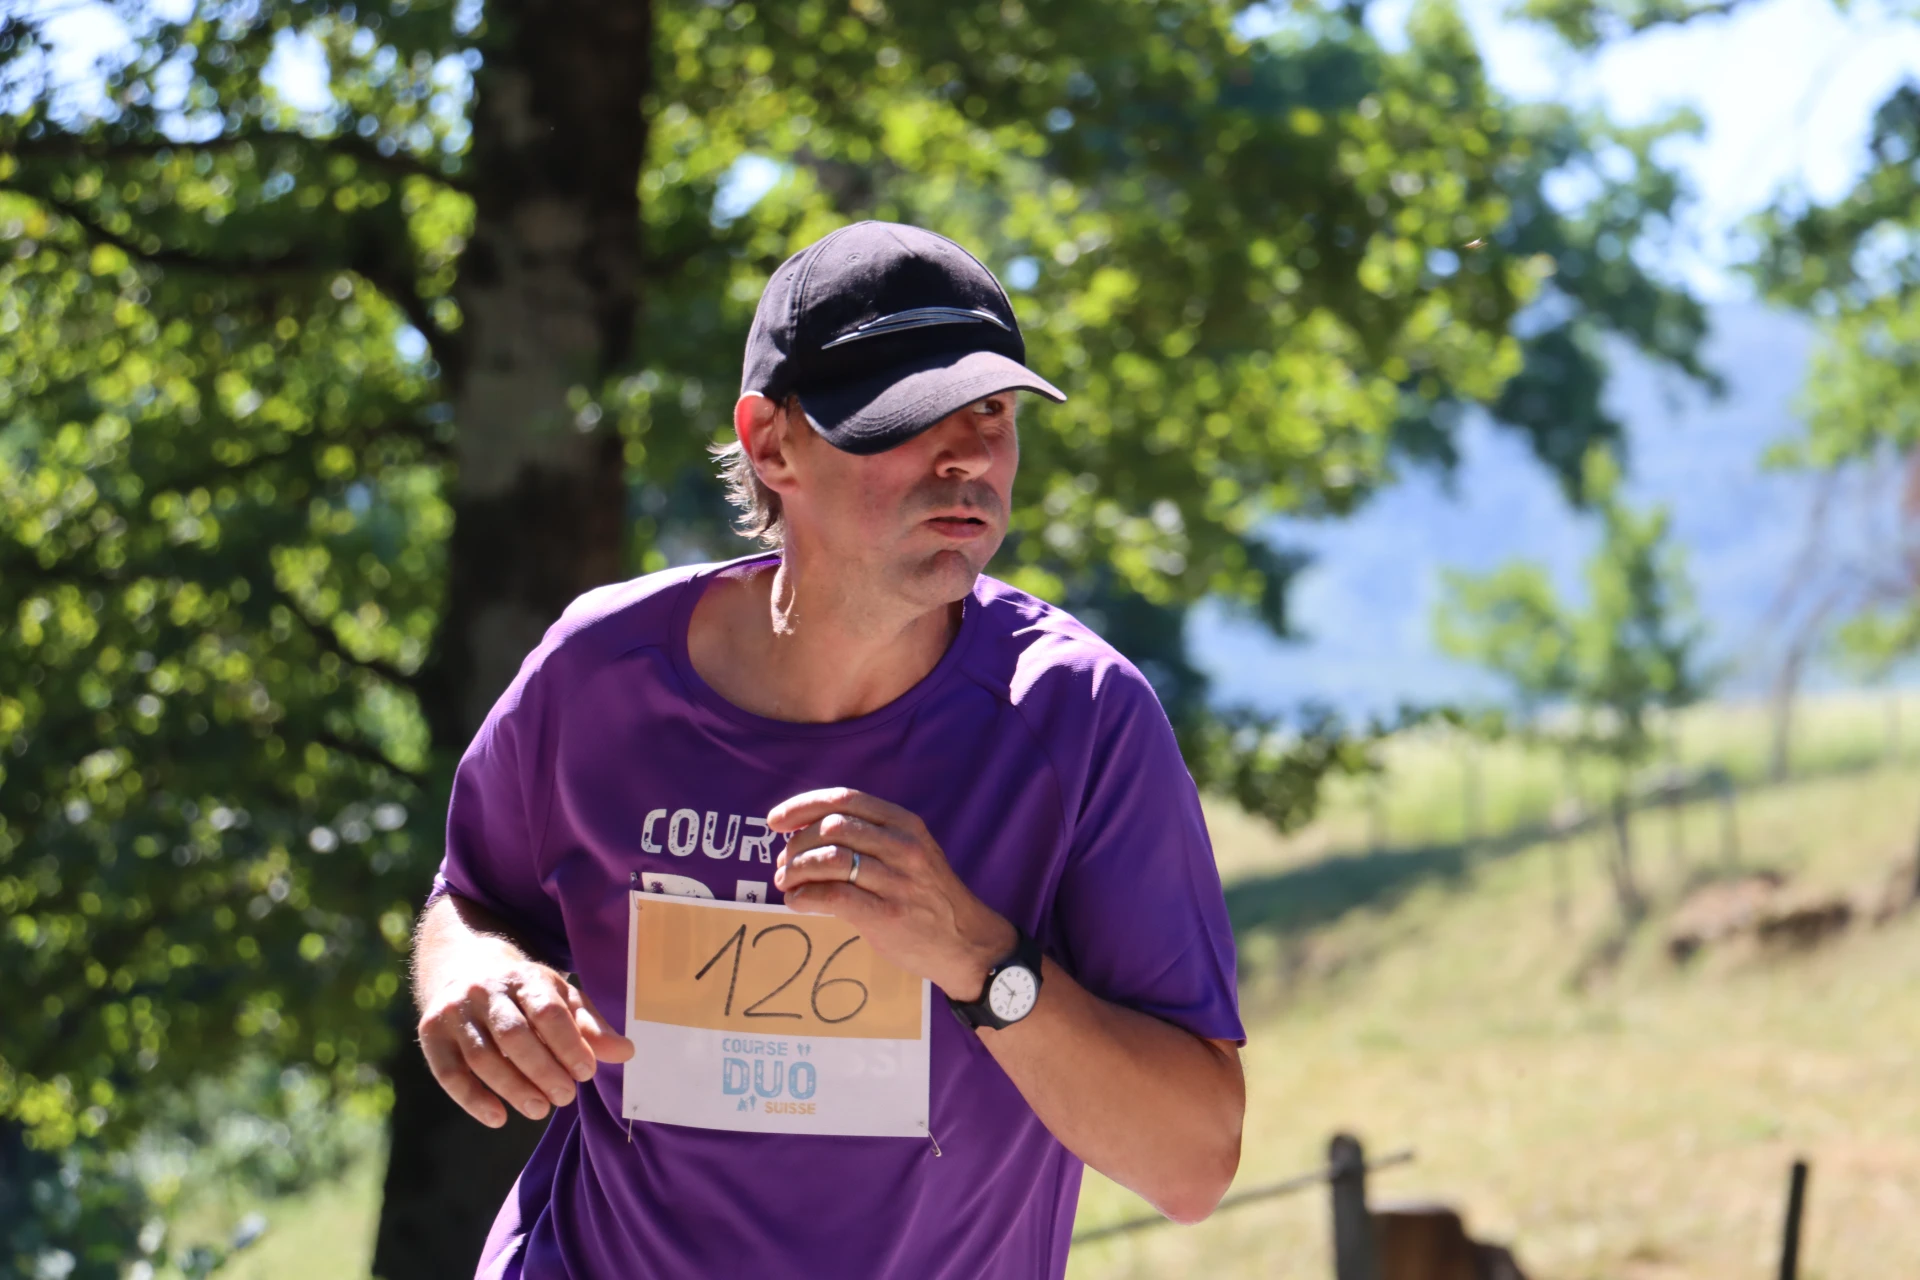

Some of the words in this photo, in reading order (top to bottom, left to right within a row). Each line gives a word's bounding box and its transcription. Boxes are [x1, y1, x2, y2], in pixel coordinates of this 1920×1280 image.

[640, 808, 795, 864] COUR
[695, 923, 868, 1023] 126
[722, 1038, 788, 1056] COURSE
[722, 1057, 817, 1101] DUO
[764, 1101, 816, 1115] SUISSE
